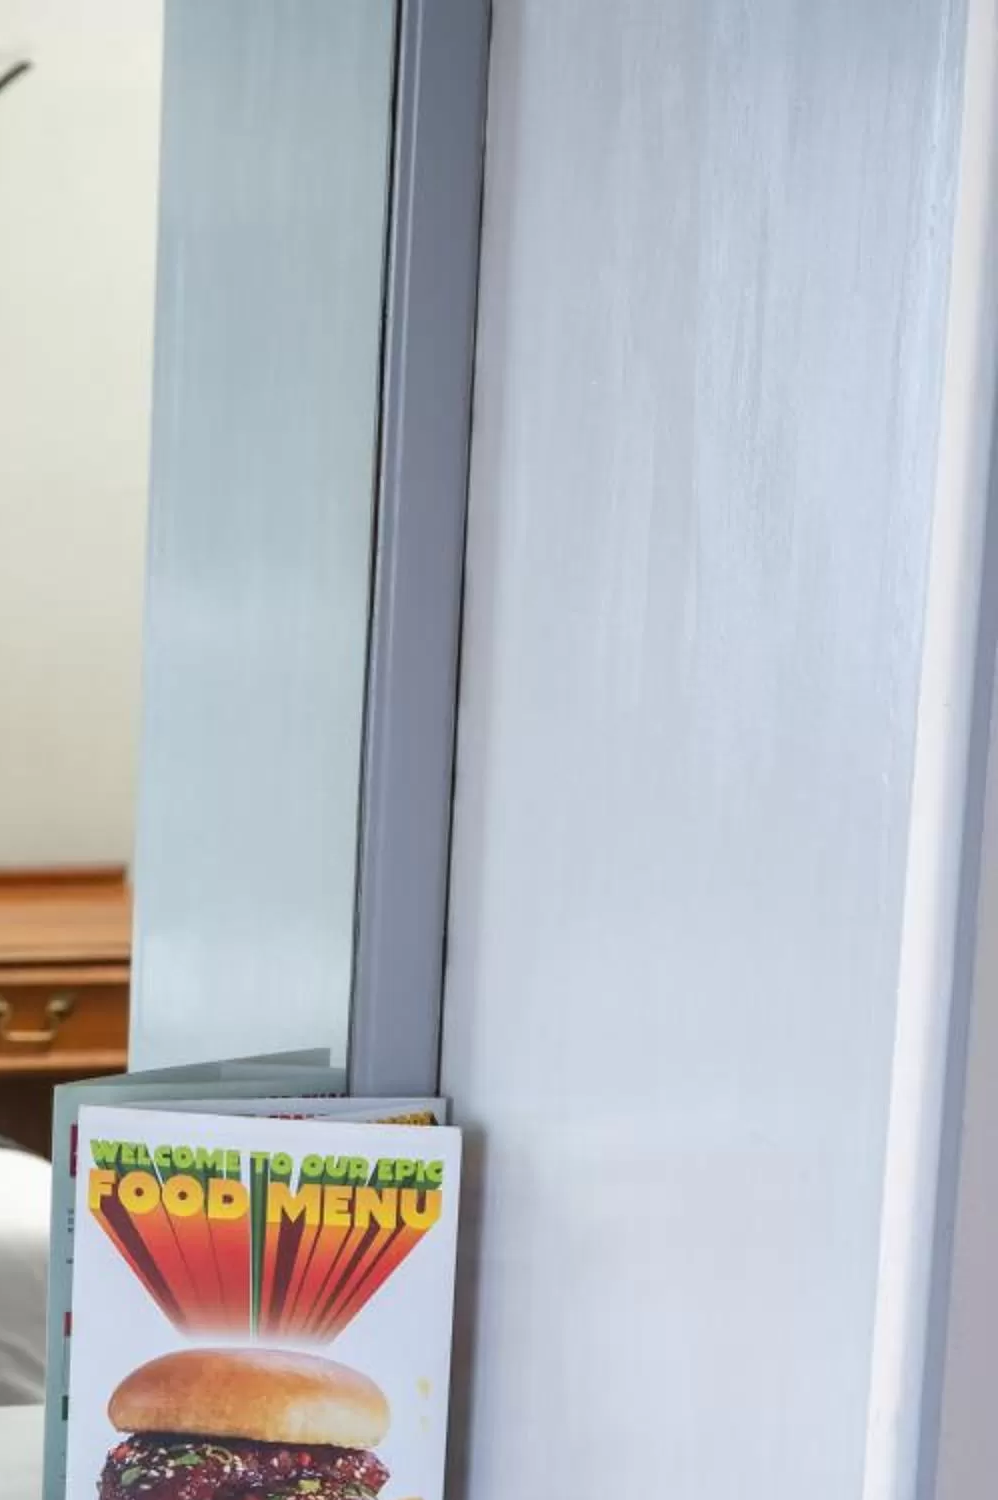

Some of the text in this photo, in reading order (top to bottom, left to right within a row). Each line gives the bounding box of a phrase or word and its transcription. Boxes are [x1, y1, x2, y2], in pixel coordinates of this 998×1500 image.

[90, 1138, 240, 1174] WELCOME
[250, 1151, 294, 1179] TO
[302, 1153, 369, 1181] OUR
[378, 1157, 445, 1184] EPIC
[88, 1167, 443, 1232] FOOD MENU
